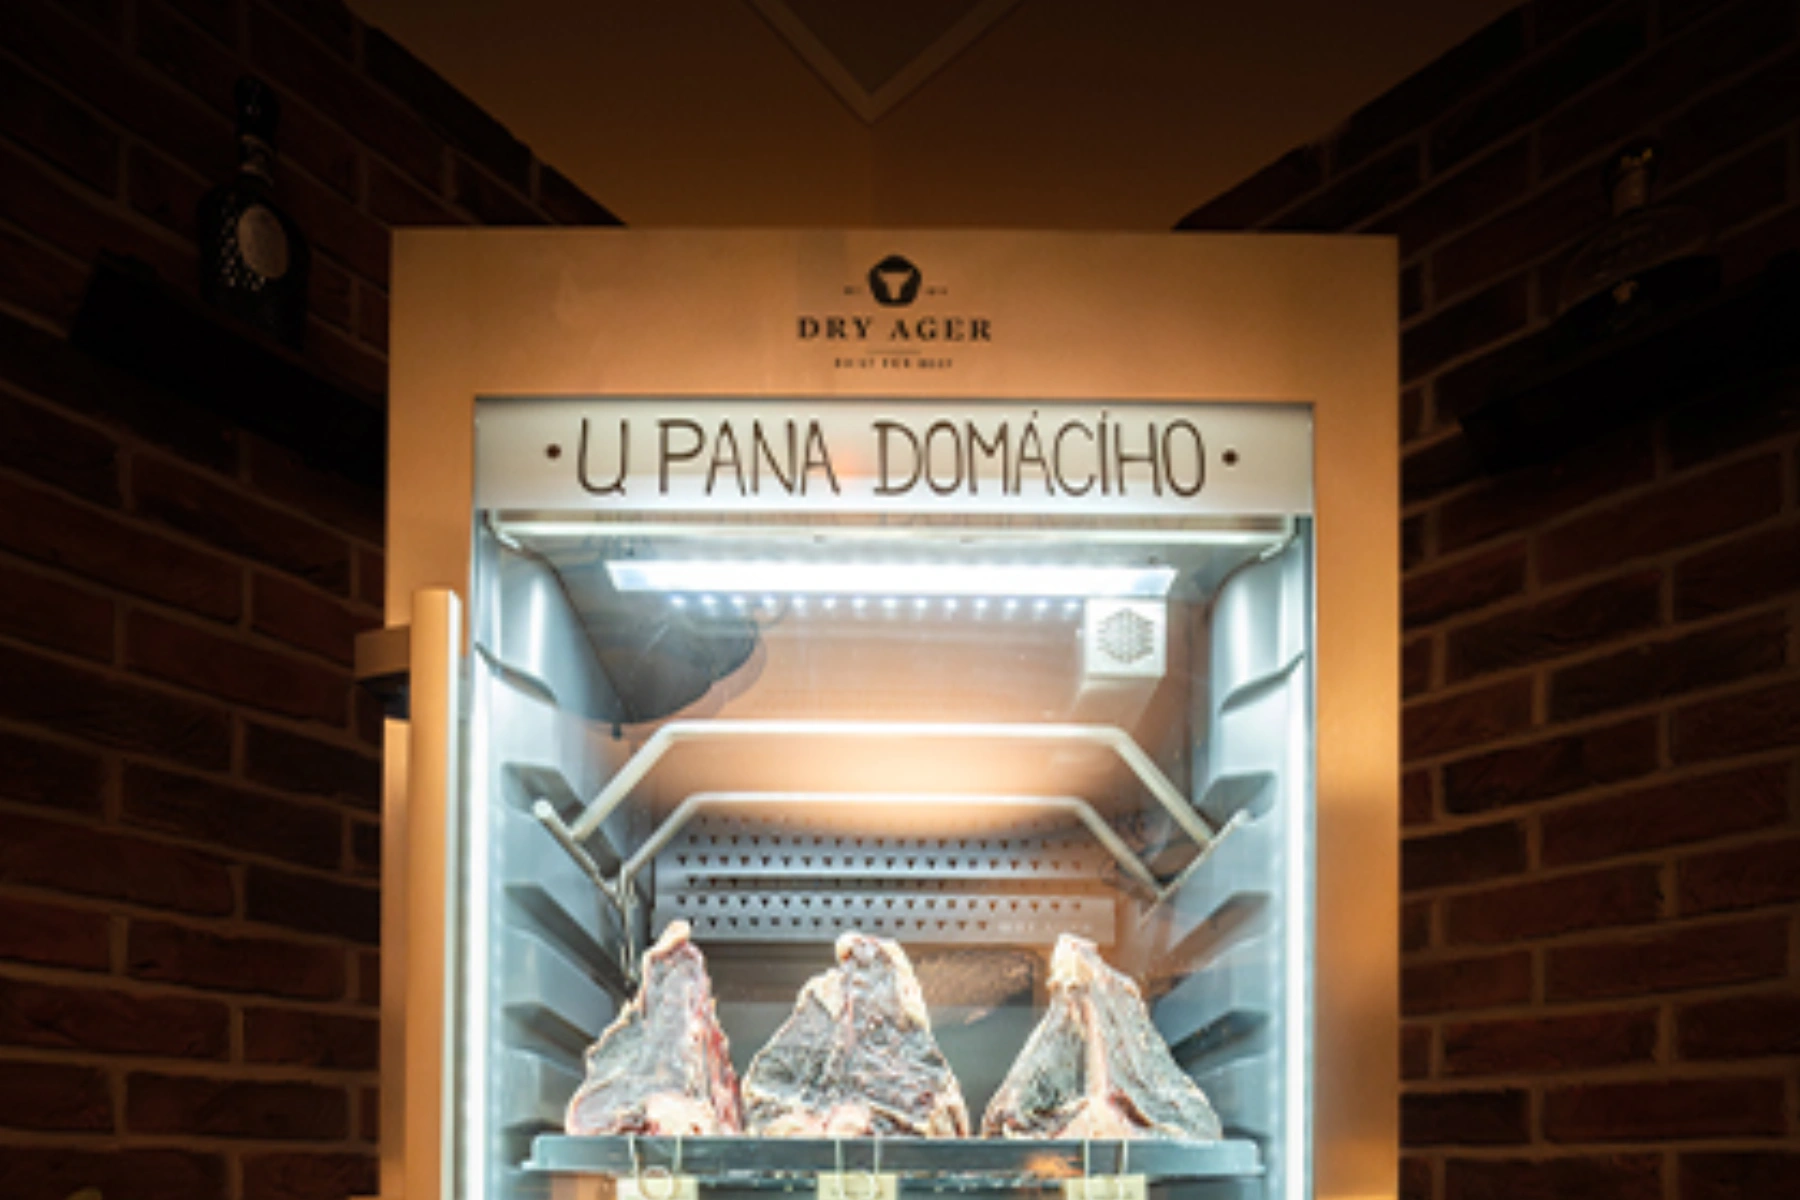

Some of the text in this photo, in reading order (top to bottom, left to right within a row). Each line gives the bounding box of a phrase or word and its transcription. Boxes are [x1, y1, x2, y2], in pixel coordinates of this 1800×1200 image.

[797, 315, 992, 342] DRY AGER
[576, 410, 1208, 498] U PANA DOMÁCÍHO
